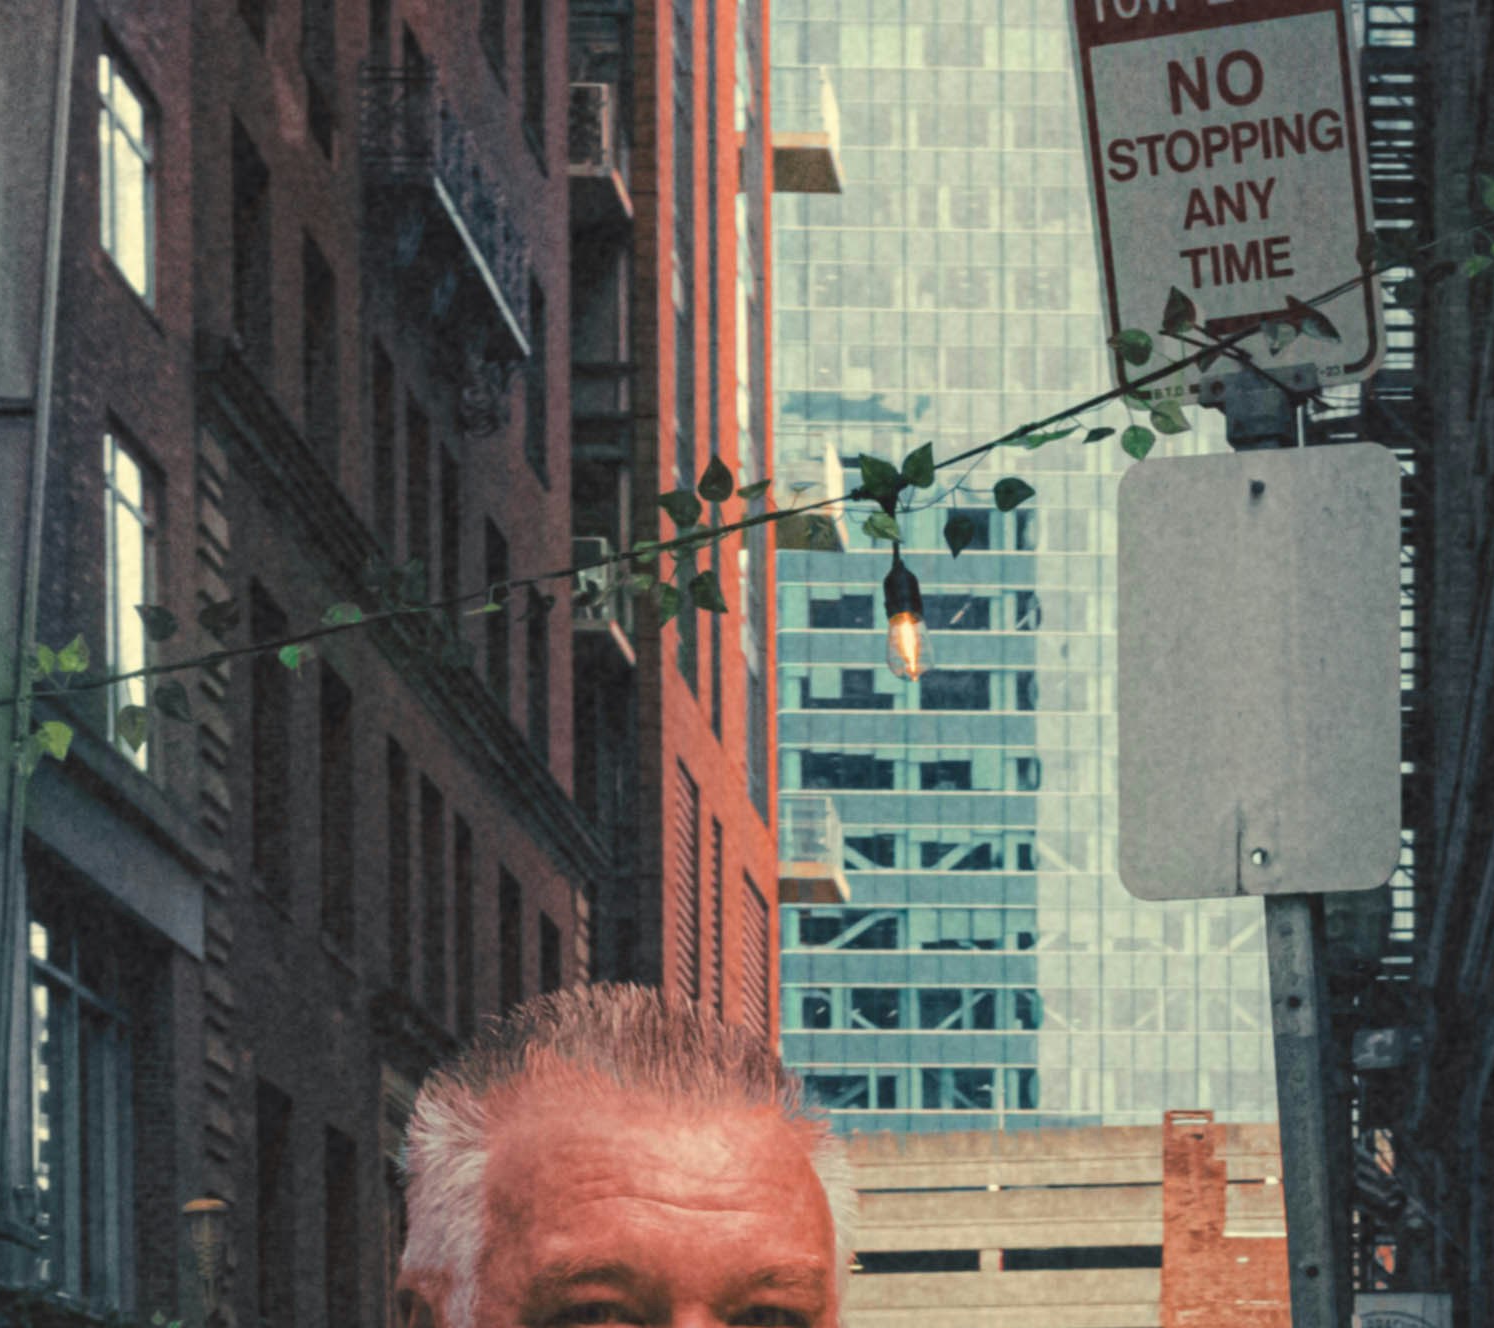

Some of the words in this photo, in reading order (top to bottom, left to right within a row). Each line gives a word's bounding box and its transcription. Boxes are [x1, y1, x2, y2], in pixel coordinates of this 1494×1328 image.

[1166, 50, 1264, 115] NO
[1107, 108, 1344, 182] STOPPING
[1183, 177, 1276, 231] ANY
[1180, 236, 1295, 290] TIME
